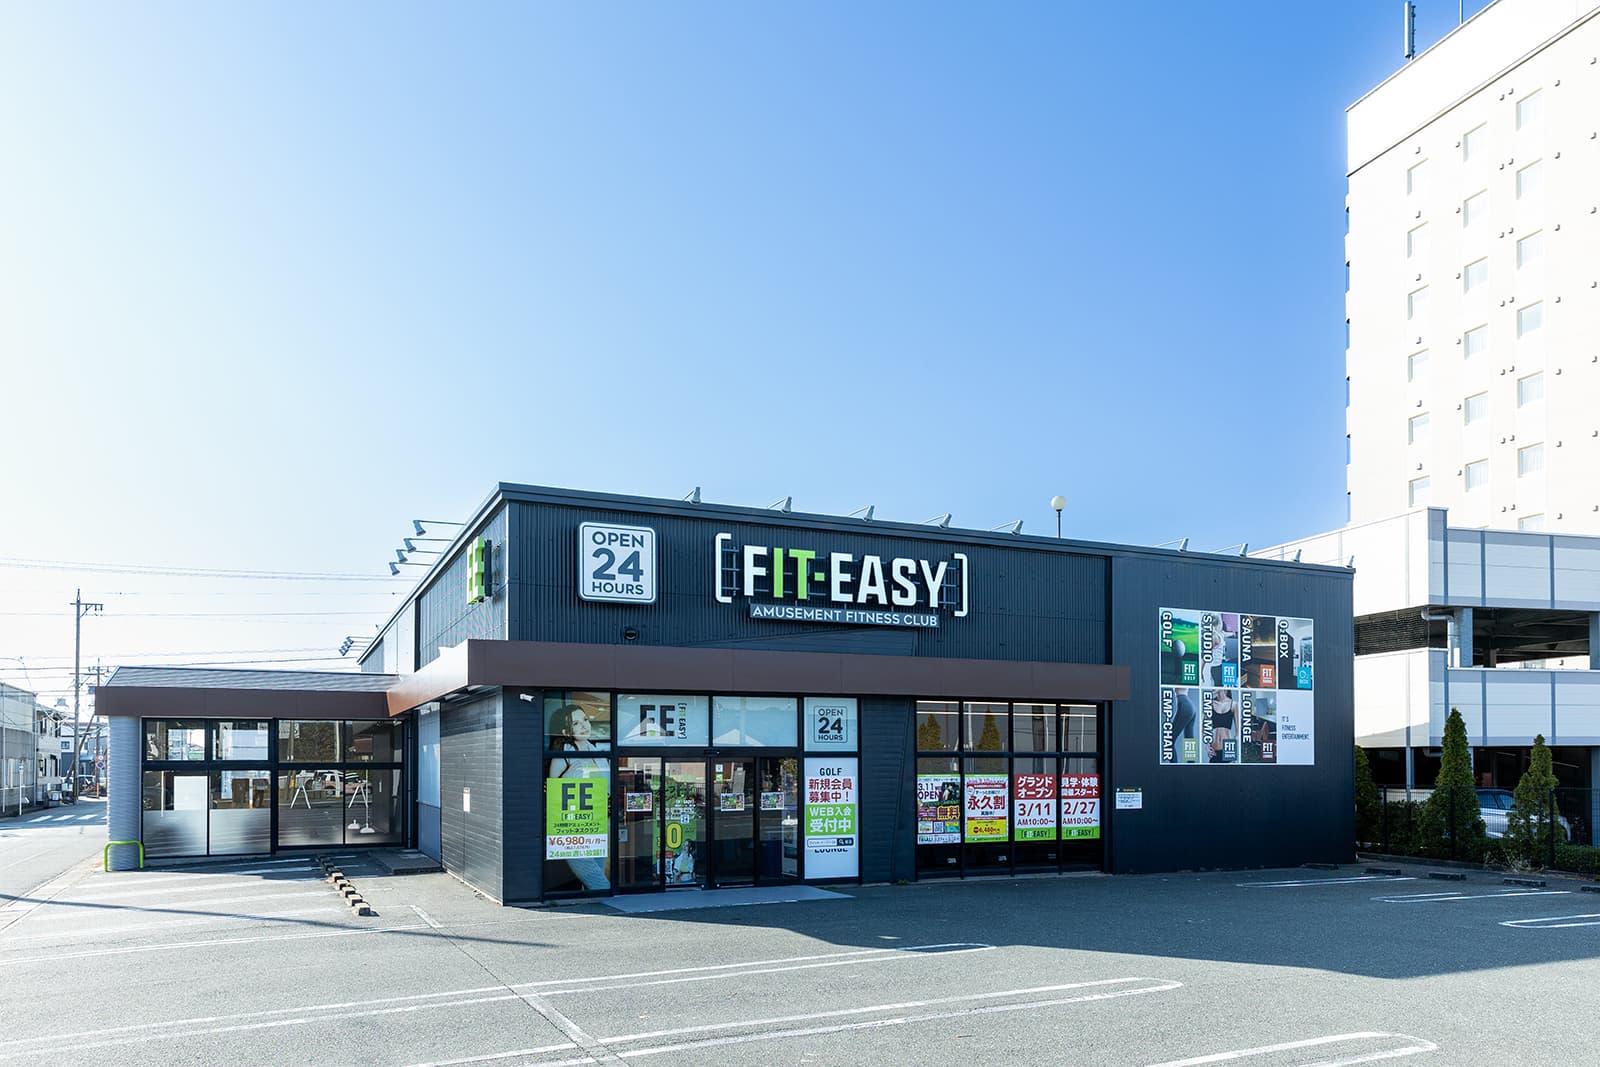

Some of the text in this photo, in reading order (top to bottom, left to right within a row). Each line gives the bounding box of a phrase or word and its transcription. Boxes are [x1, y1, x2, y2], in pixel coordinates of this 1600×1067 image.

[592, 531, 644, 548] OPEN
[592, 547, 644, 582] 24
[592, 581, 644, 595] HOURS
[752, 606, 937, 626] AMUSEMENT FITNESS CLUB
[1162, 612, 1172, 647] GOLF
[1203, 615, 1212, 662] STUDIO
[1242, 618, 1251, 661] SAUNA
[1184, 664, 1196, 673] FIT
[1224, 666, 1234, 675] FIT
[1262, 668, 1272, 678] FIT
[818, 708, 843, 716] OPEN
[1242, 693, 1251, 743] LOUNGE
[818, 717, 843, 734] 24
[1163, 690, 1173, 760] EMP-CHAIR
[1184, 741, 1195, 750] FIT
[1224, 742, 1235, 751] FIT
[1262, 742, 1273, 751] FIT
[819, 767, 842, 776] GOLF
[809, 778, 852, 790] 新規会員
[1018, 776, 1053, 787] グランド
[809, 791, 849, 803] 募集中!
[918, 791, 941, 800] OPEN
[1018, 788, 1053, 798] オープン
[968, 795, 1005, 810] 永久割
[1018, 802, 1050, 816] 3/11
[1064, 801, 1096, 815] 2/27
[809, 806, 851, 817] WEB入会
[810, 818, 851, 833] 受付中
